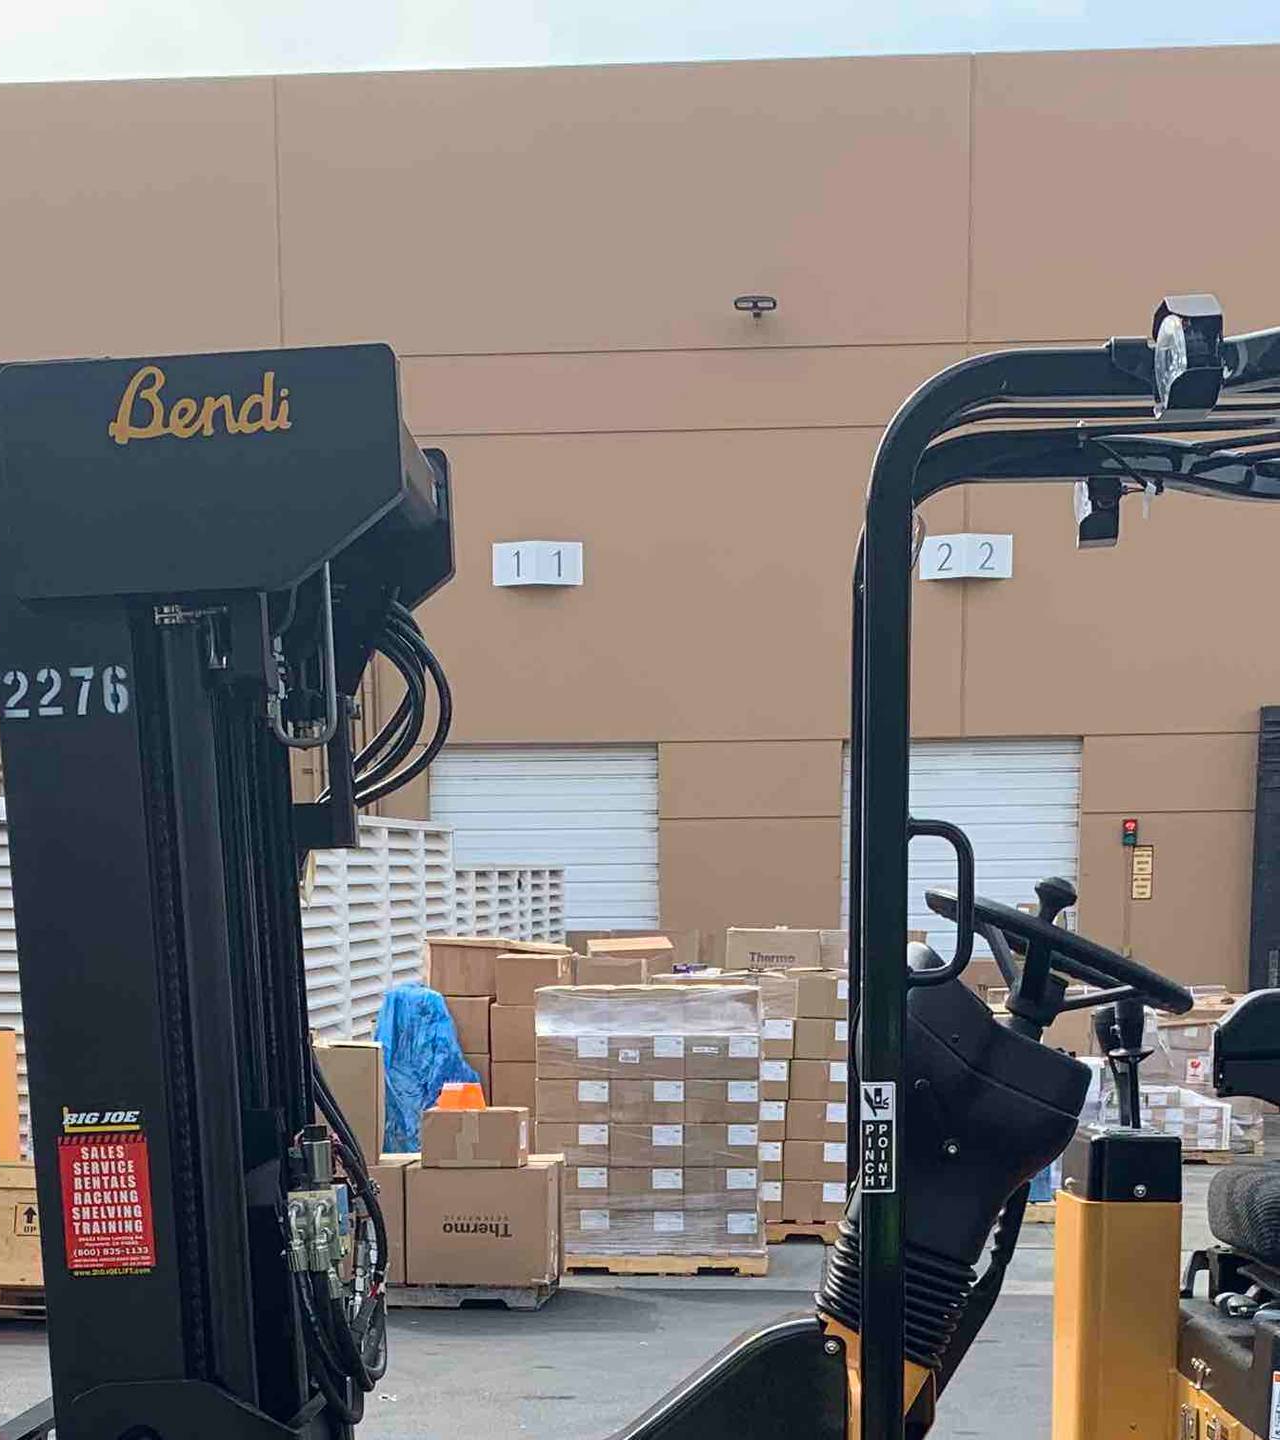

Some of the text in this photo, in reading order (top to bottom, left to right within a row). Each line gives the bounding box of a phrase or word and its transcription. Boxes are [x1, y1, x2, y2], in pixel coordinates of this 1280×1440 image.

[108, 365, 292, 445] Bendi
[937, 541, 995, 571] 2 2
[2, 665, 129, 718] 2276
[749, 952, 796, 963] Thermo
[62, 1110, 140, 1125] BIG JOE
[80, 1145, 125, 1160] SALES
[865, 1124, 875, 1187] PINCH
[878, 1124, 889, 1187] POINT
[73, 1160, 135, 1175] SERVICE
[73, 1176, 137, 1190] RENTALS
[73, 1190, 139, 1205] RACKING
[72, 1205, 143, 1220] SHELVING
[23, 1226, 37, 1234] UP
[73, 1220, 143, 1235] TRAINING
[443, 1223, 513, 1238] Thermo
